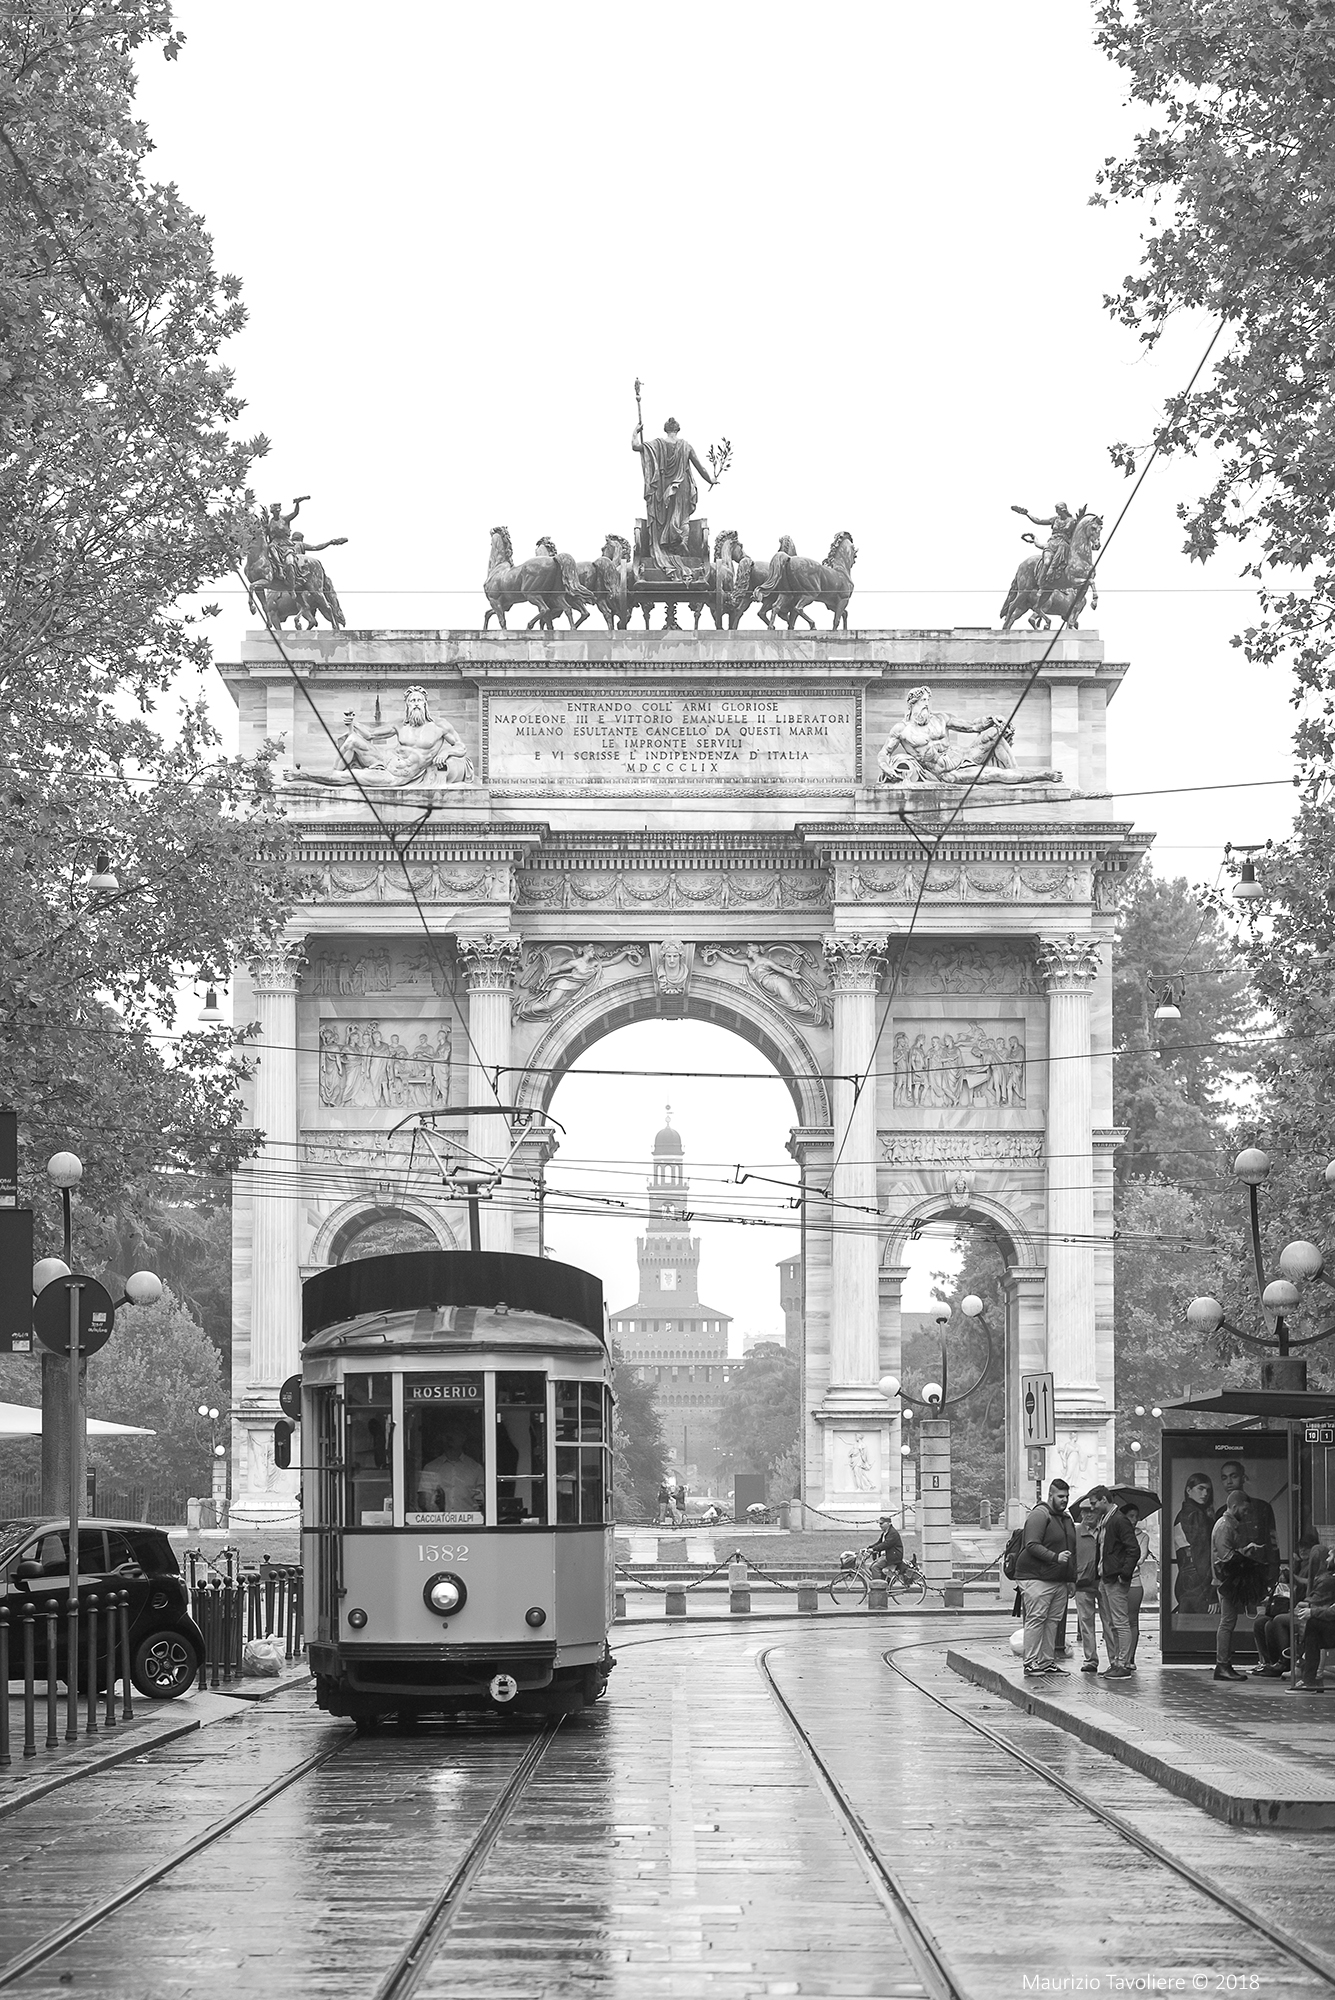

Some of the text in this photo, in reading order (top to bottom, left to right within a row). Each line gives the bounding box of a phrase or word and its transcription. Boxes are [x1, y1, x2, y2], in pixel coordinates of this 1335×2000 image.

[567, 702, 632, 712] ENTRANDO
[682, 702, 712, 712] ARMI
[721, 702, 779, 712] GLORIOSE
[494, 714, 850, 724] NAPOLEONE III E VITTORIO EMANUELE II LIBERATORI
[516, 727, 564, 736] MILANO
[573, 727, 638, 736] ESULTANTE
[715, 726, 730, 736] DA
[739, 726, 781, 737] QUESTI
[789, 726, 829, 736] MARMI
[602, 739, 742, 749] LE IMPRONTE SERVILI
[534, 751, 541, 760] E
[552, 751, 564, 760] VI
[574, 751, 620, 760] SCRISSE
[645, 751, 740, 760] INDIPENDENZA
[767, 751, 809, 760] ITALIA
[413, 1386, 477, 1398] ROSERIO
[415, 1513, 474, 1523] CACCIATORI ALPI
[418, 1544, 469, 1562] 1582
